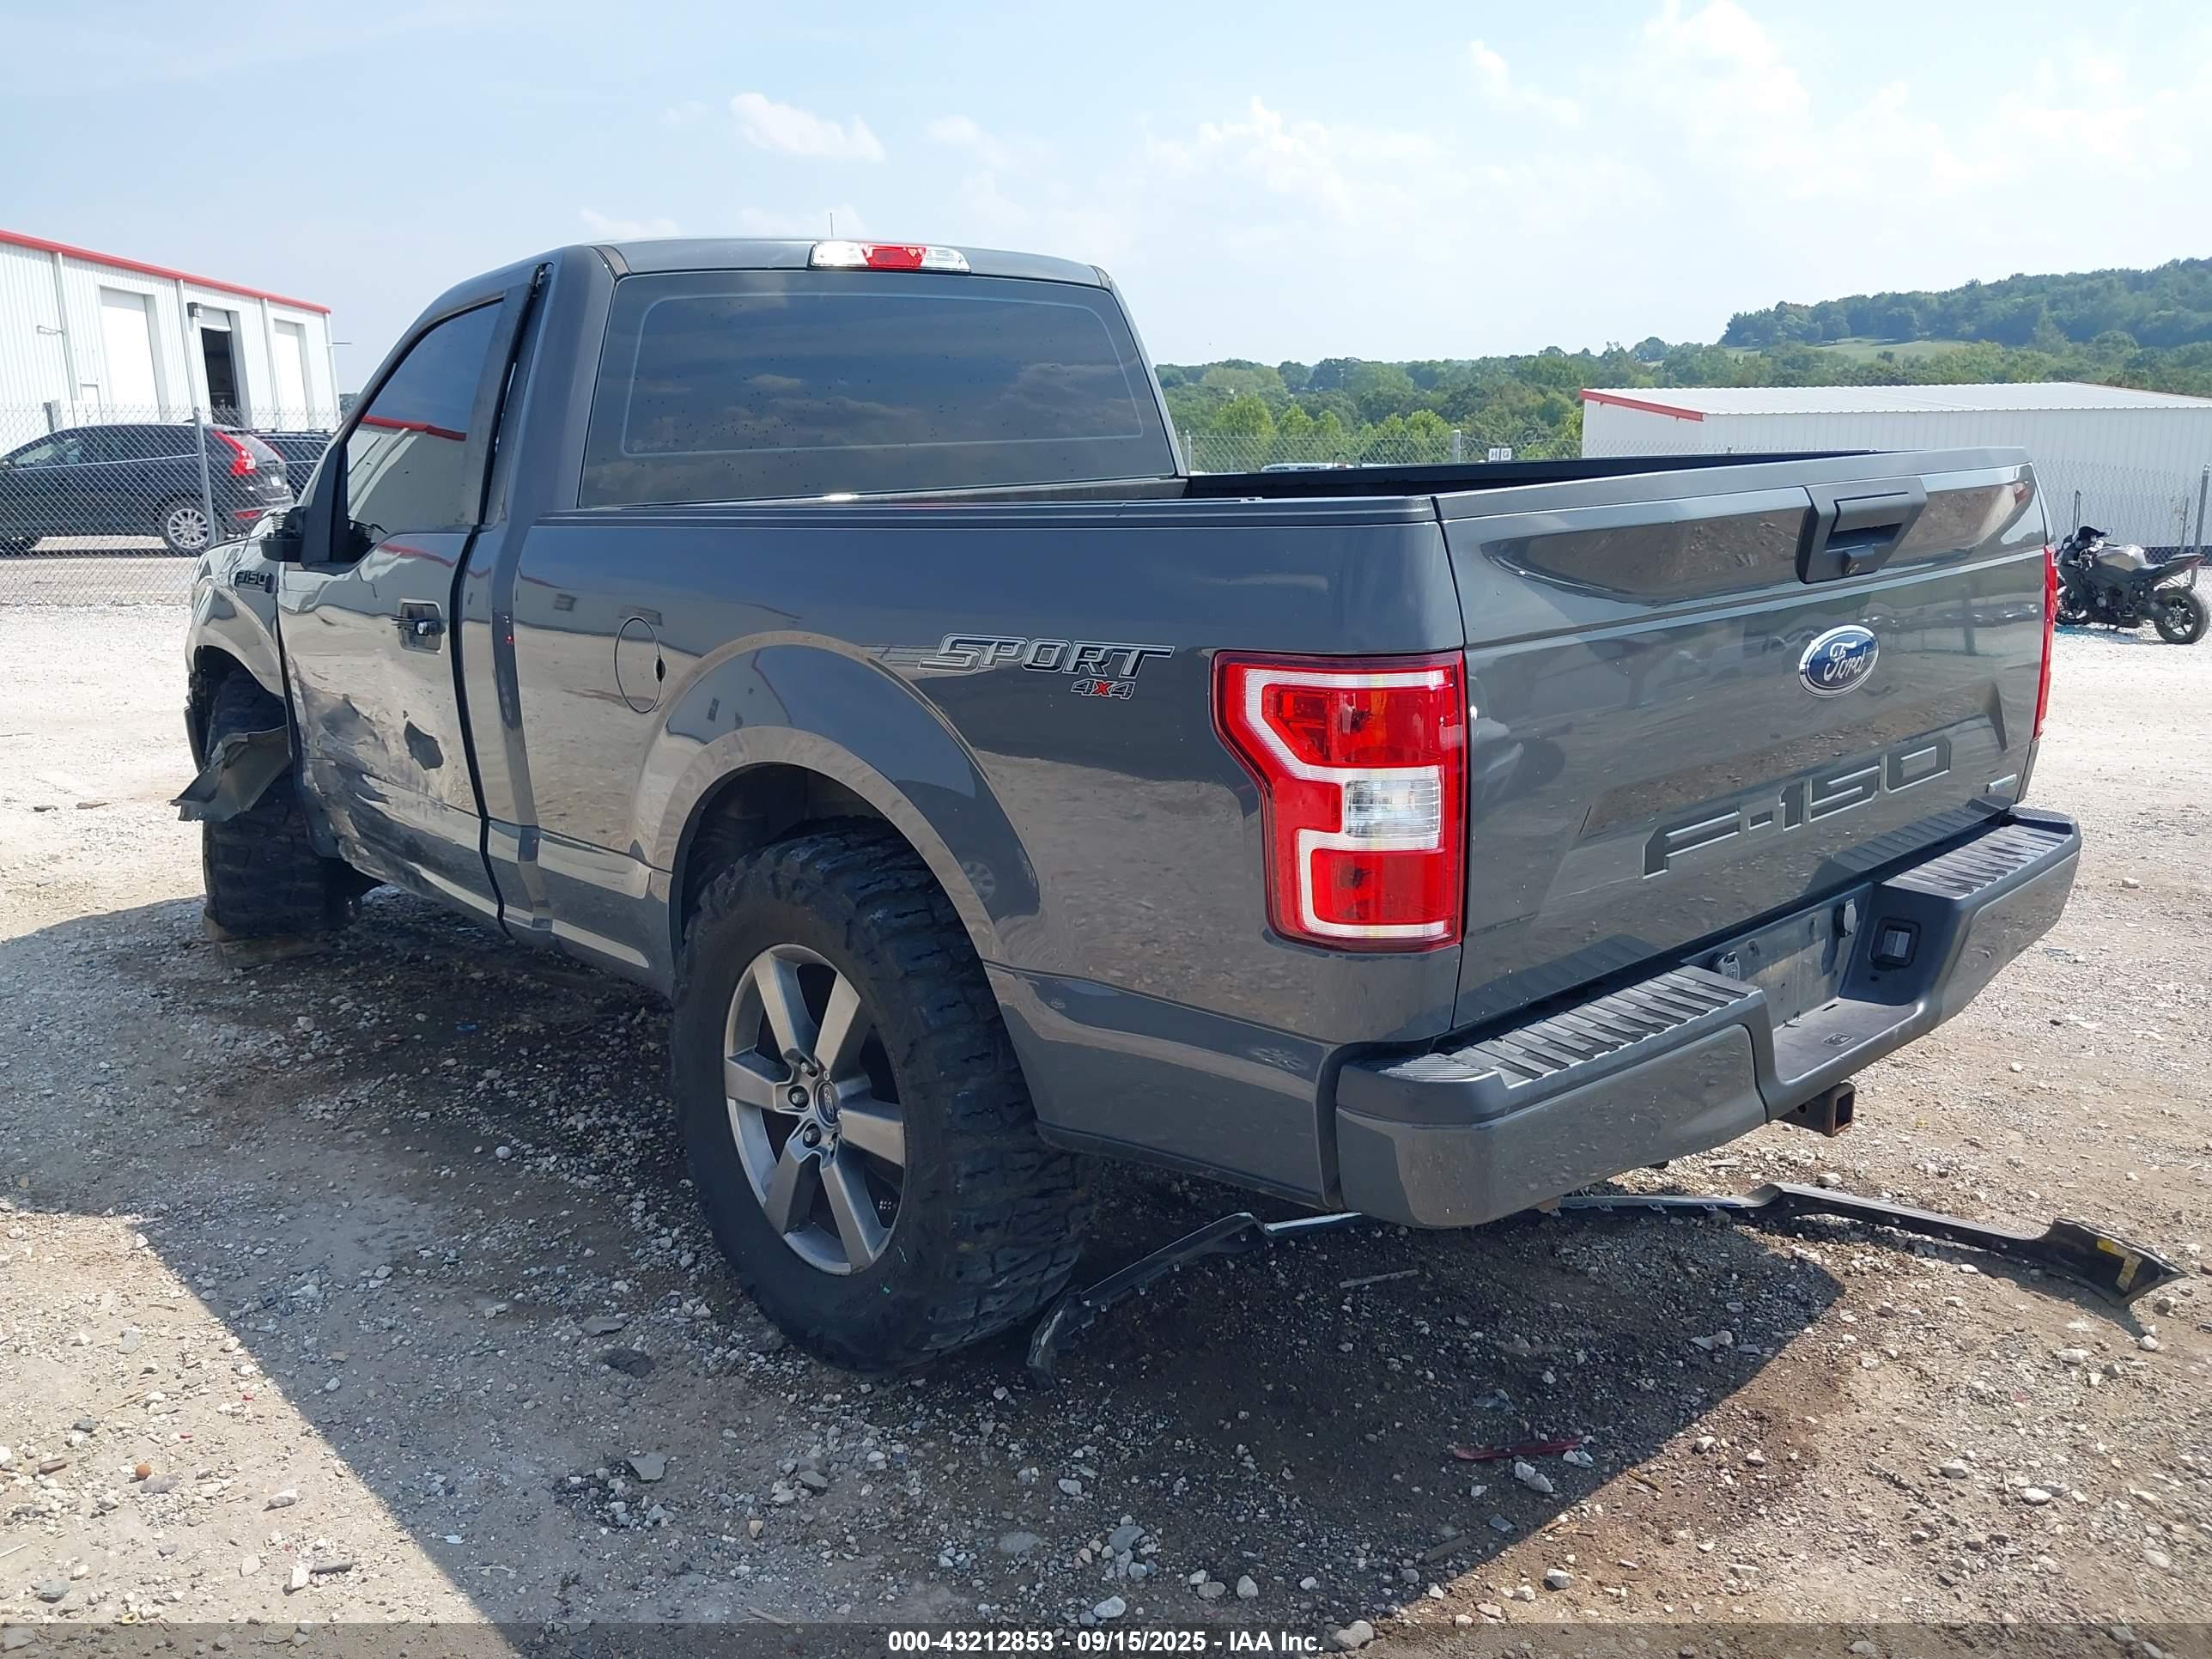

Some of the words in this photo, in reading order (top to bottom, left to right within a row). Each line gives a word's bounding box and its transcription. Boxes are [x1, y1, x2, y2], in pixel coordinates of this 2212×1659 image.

[917, 633, 1176, 679] SPORT
[1823, 640, 1867, 682] Ford
[1642, 734, 1952, 879] F-150
